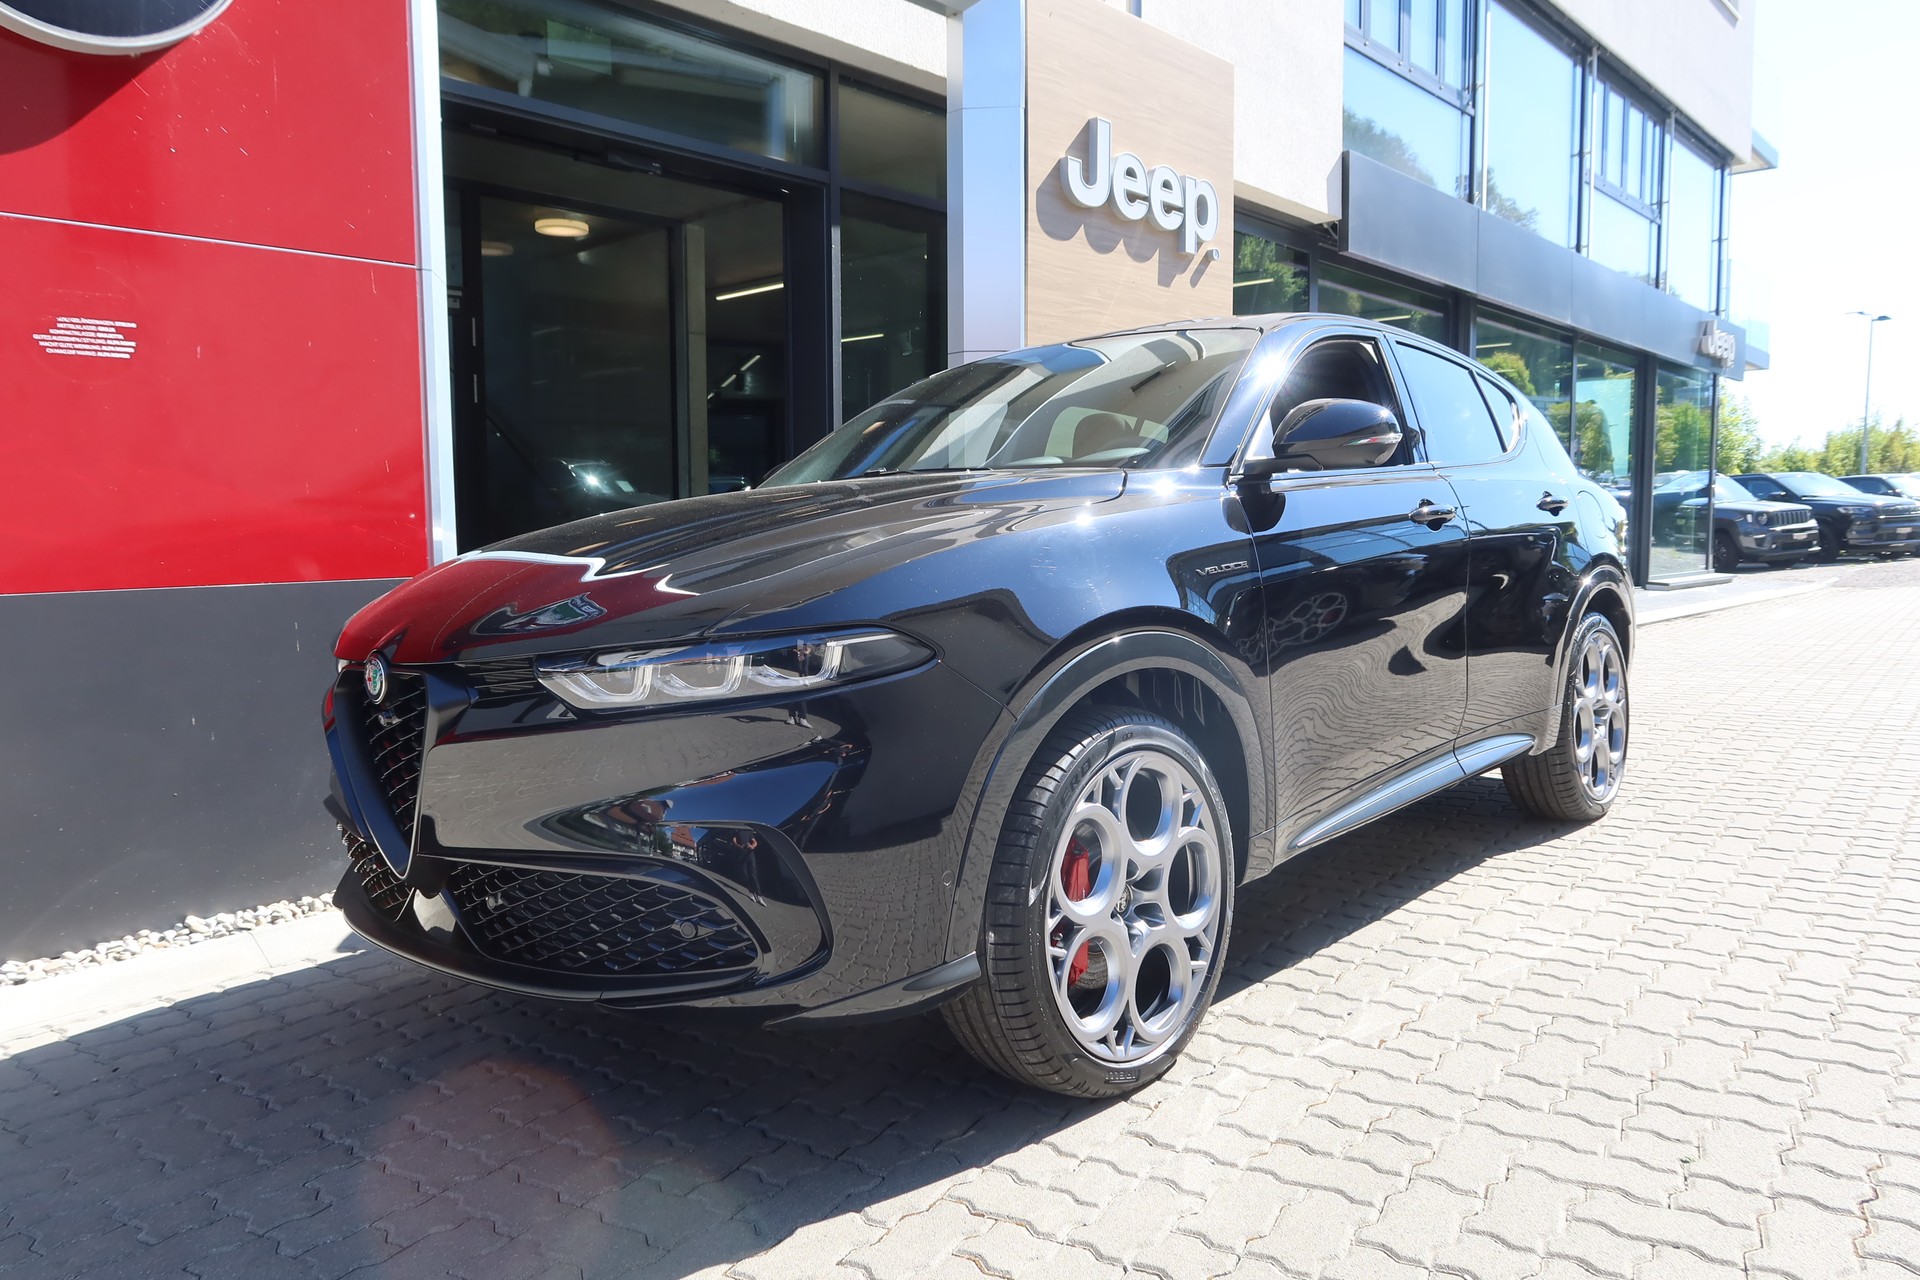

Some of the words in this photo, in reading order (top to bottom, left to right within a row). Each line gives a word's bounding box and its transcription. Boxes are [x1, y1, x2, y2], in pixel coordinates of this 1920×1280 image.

[1059, 116, 1219, 256] Jeep
[1701, 320, 1736, 367] Jeep
[1195, 560, 1249, 576] VELOCE
